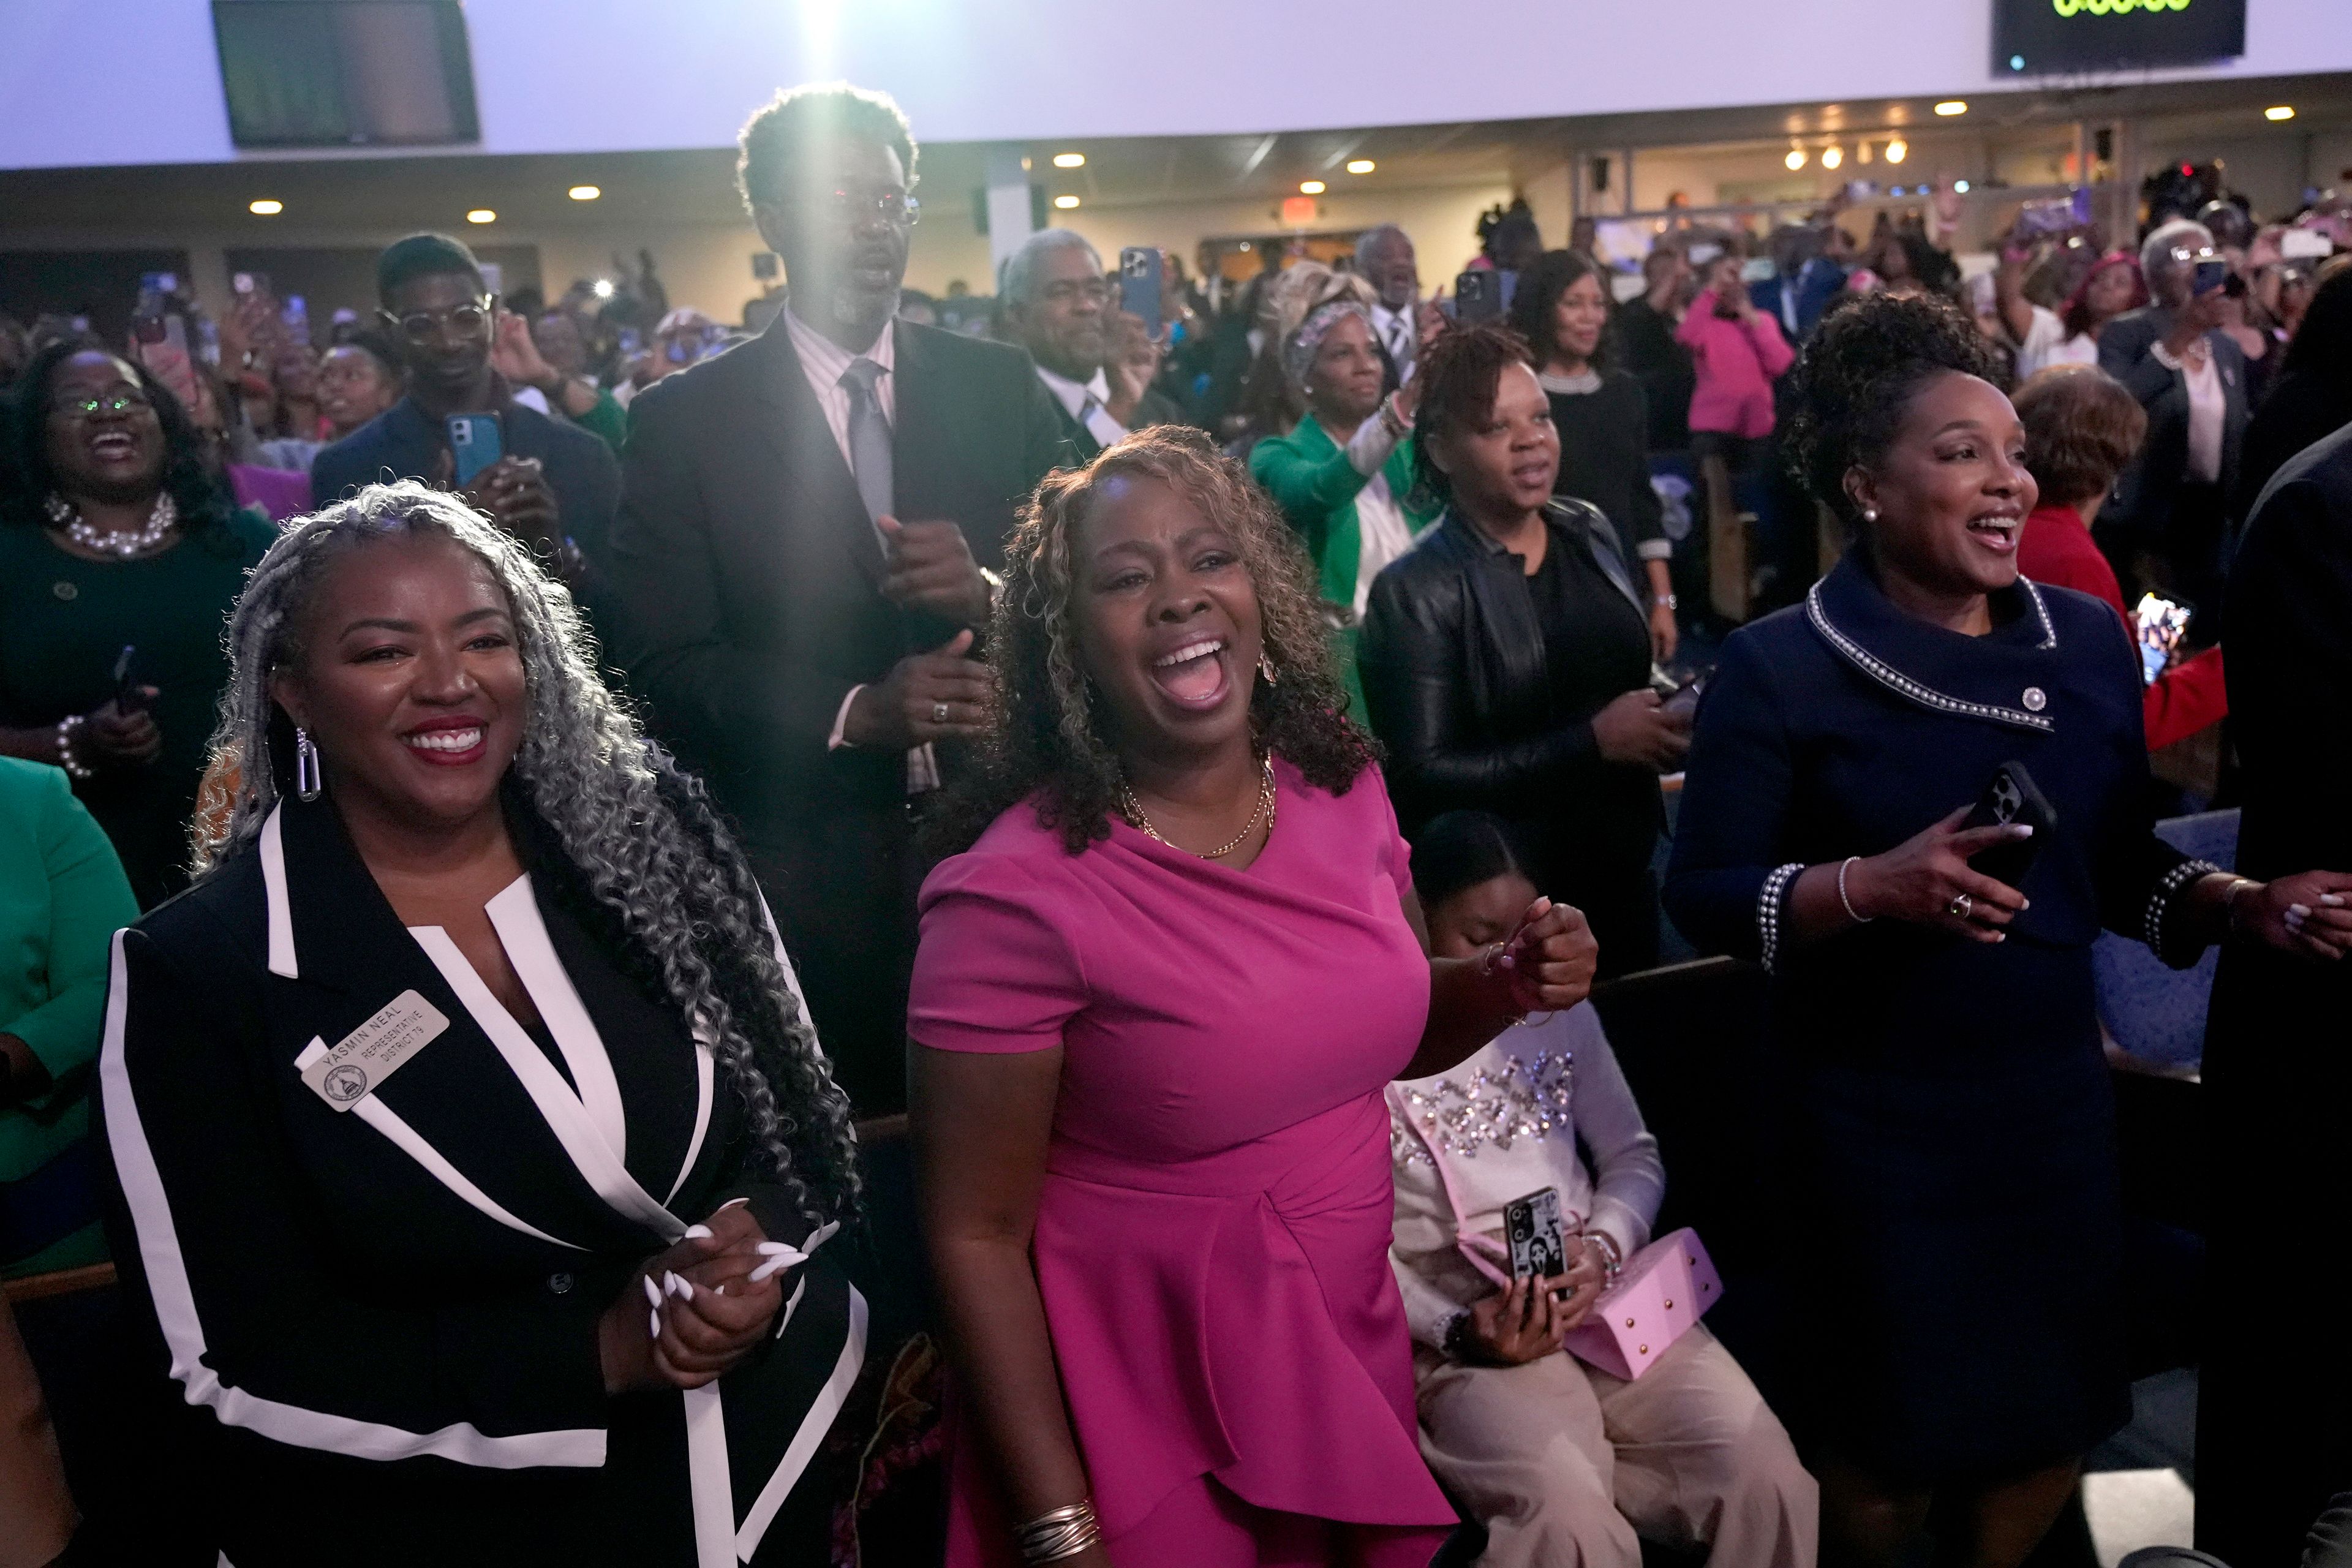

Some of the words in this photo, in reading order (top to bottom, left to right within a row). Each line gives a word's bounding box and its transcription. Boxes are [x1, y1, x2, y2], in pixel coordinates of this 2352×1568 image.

[323, 1030, 369, 1066] YASMIN
[369, 1006, 402, 1031] NEAL
[361, 1010, 423, 1060] REPRESENTATIVE
[380, 1034, 414, 1062] DISTRICT
[412, 1026, 424, 1036] 79
